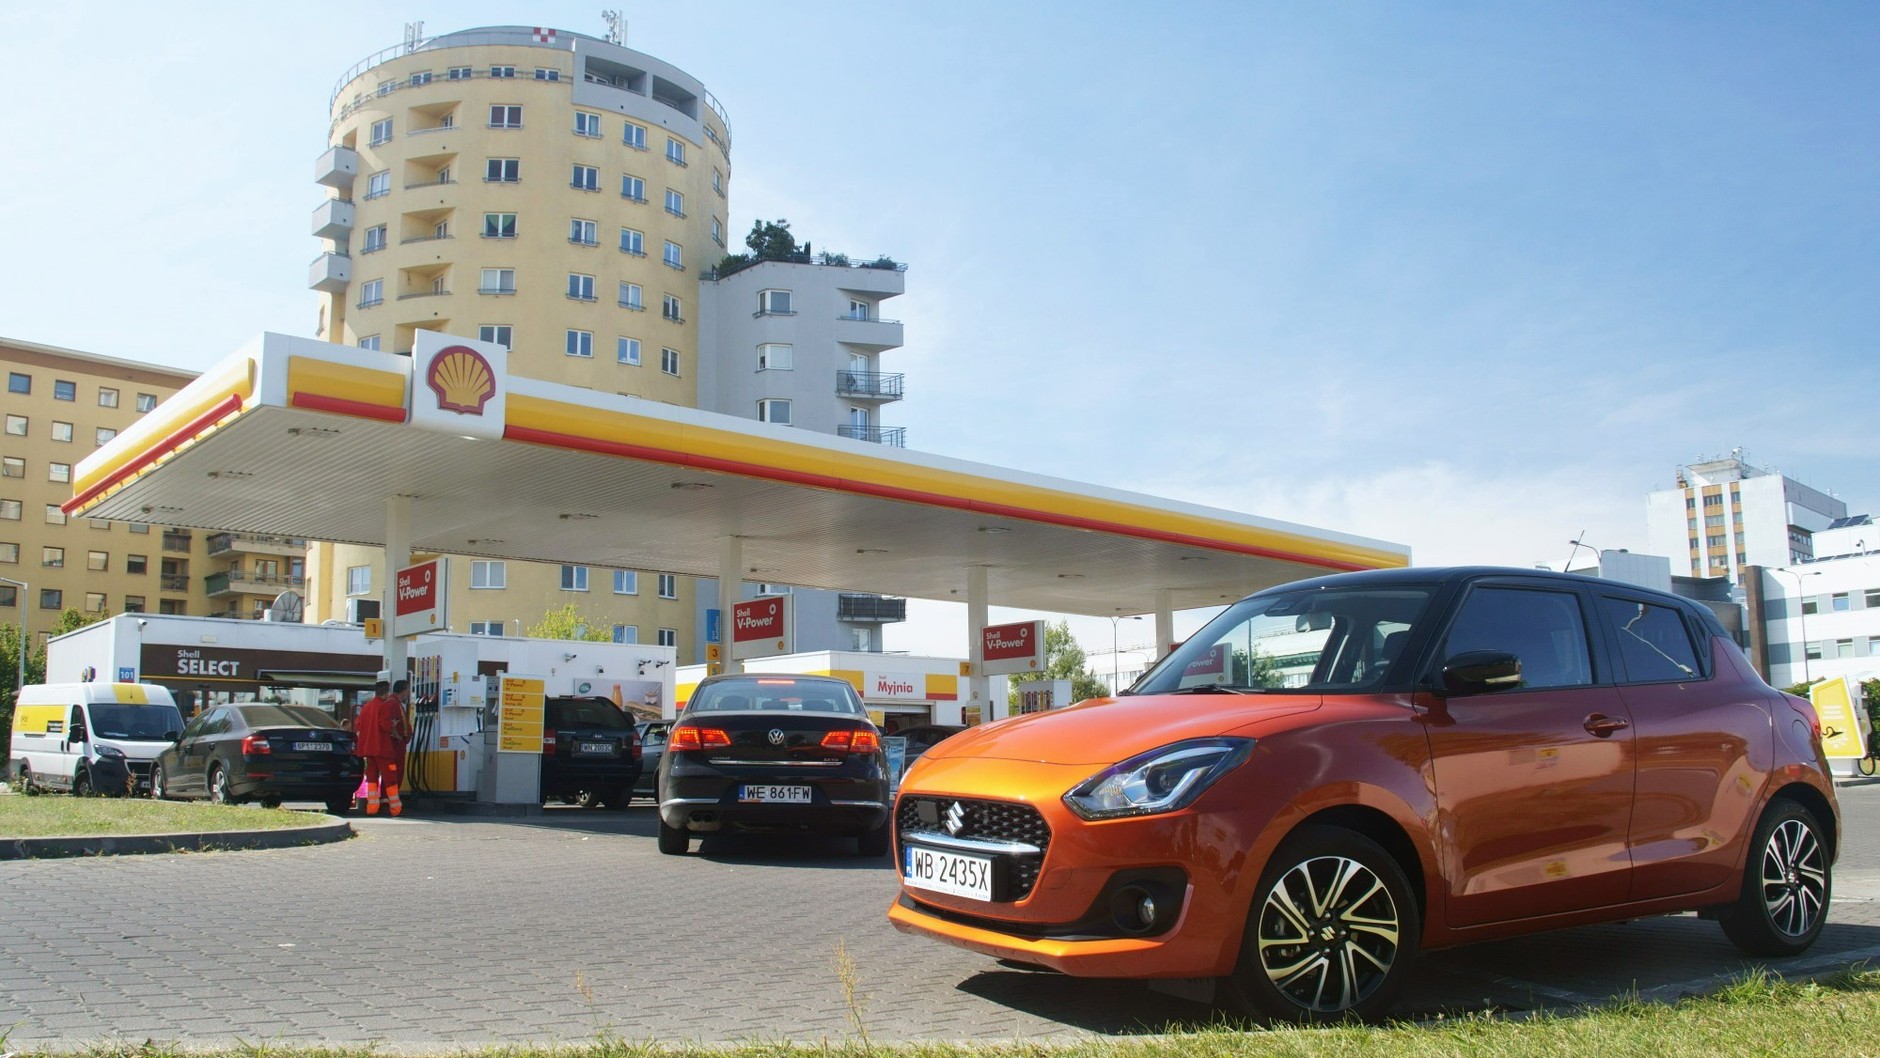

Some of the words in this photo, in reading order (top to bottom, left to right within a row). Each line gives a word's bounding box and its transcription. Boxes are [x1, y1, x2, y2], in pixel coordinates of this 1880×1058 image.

[399, 575, 411, 587] Shell
[399, 585, 428, 601] V-Power
[736, 608, 750, 618] Shell
[372, 624, 377, 633] 1
[737, 617, 773, 629] V-Power
[986, 631, 1000, 640] Shell
[986, 639, 1025, 650] V-Power
[177, 649, 200, 658] Shell
[712, 649, 718, 658] 3
[177, 659, 240, 676] SELECT
[120, 671, 134, 680] 101
[878, 681, 913, 695] Myjnia
[747, 787, 765, 799] WE
[770, 787, 810, 799] 861FW
[915, 850, 934, 879] WB
[939, 856, 988, 891] 2435X
